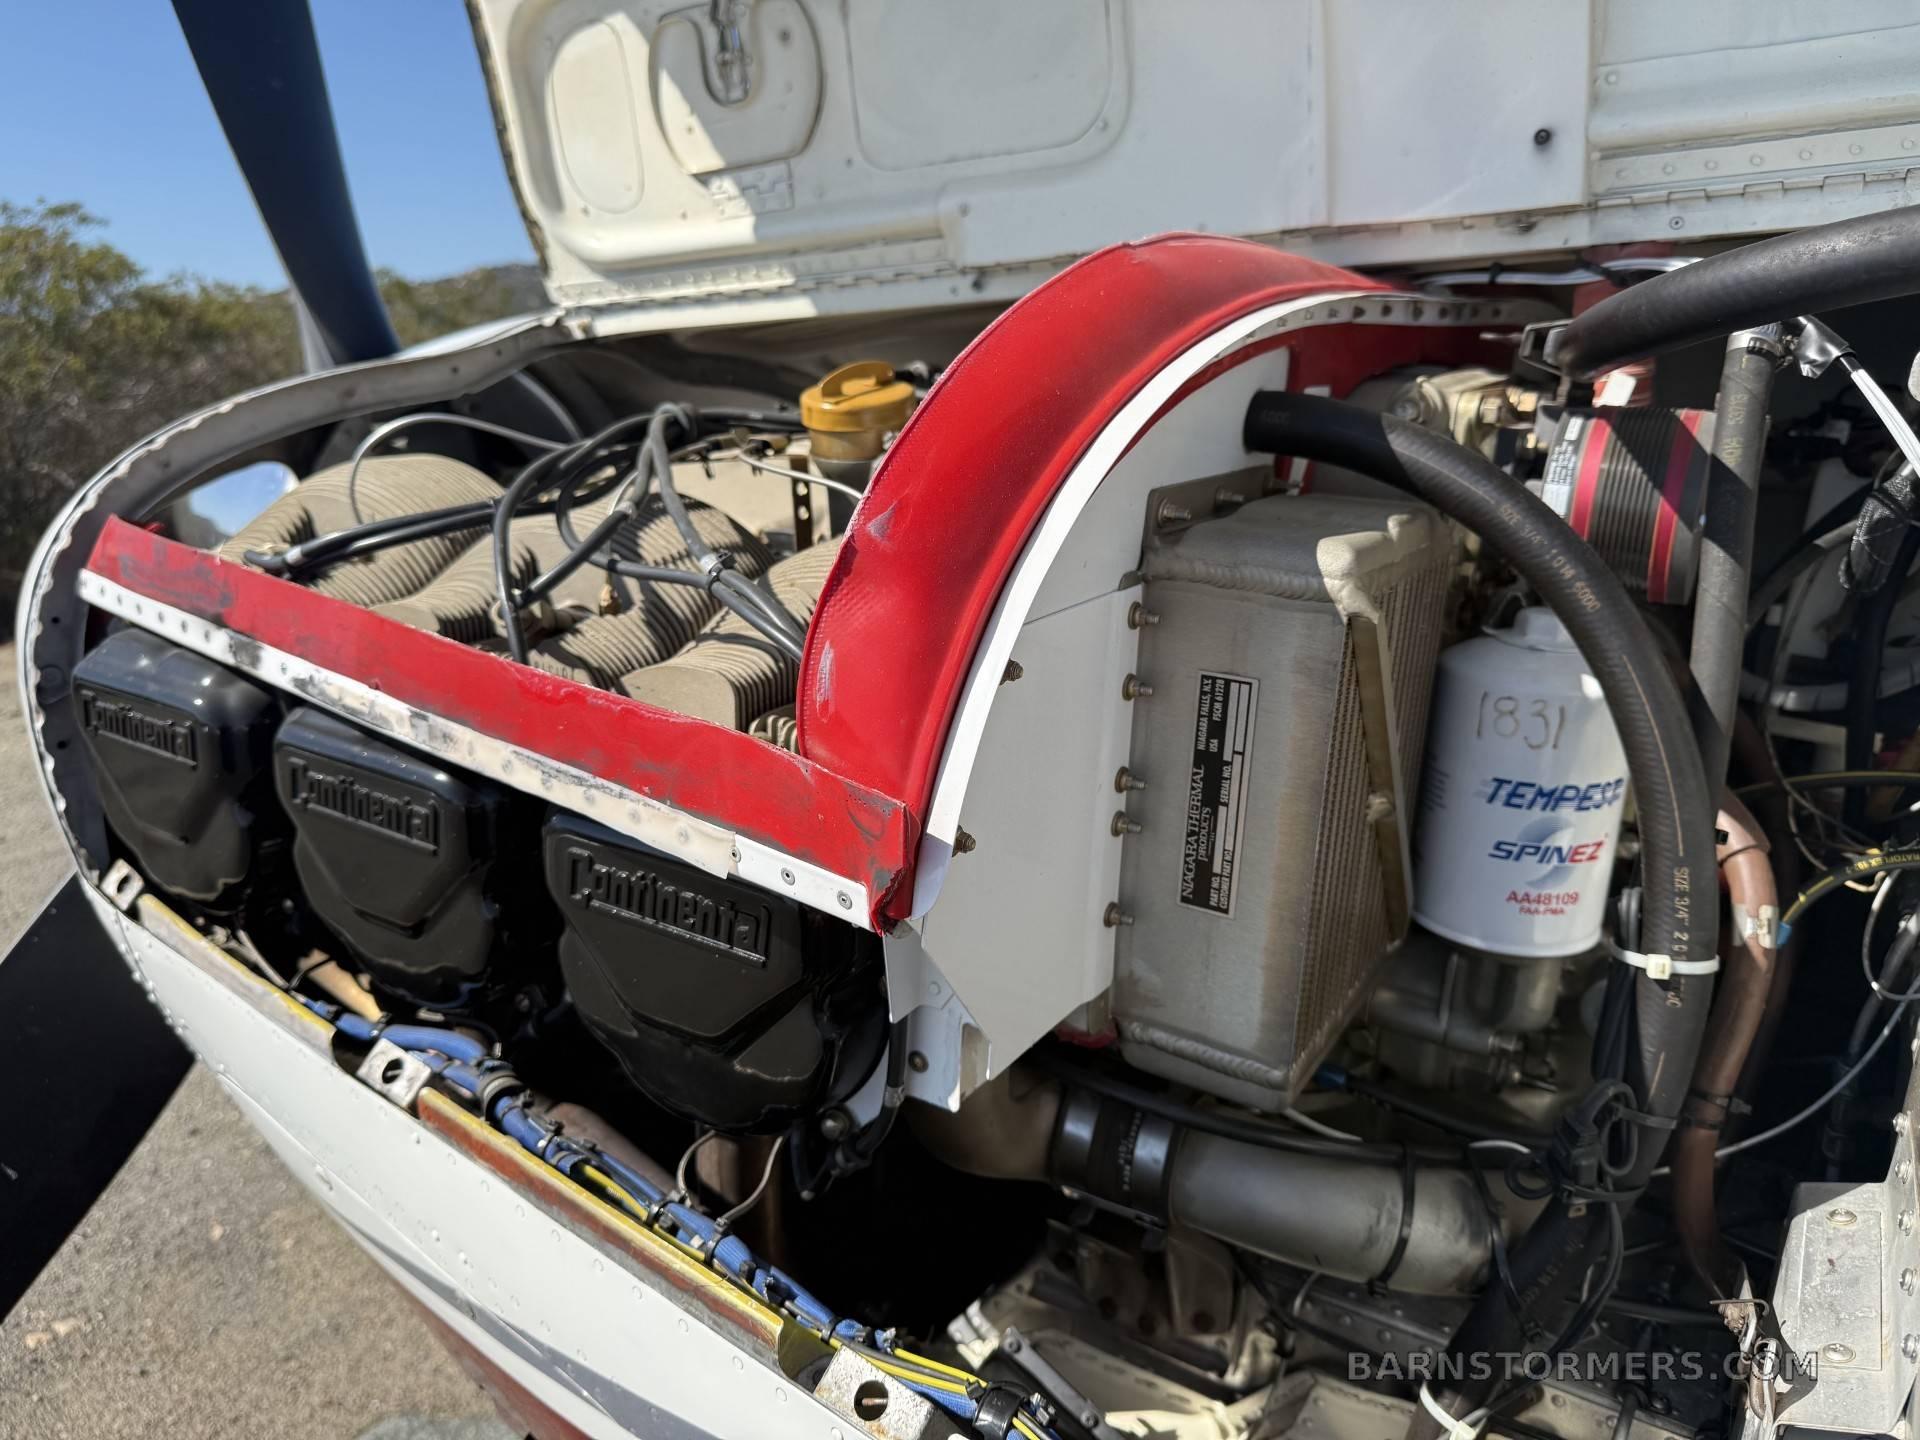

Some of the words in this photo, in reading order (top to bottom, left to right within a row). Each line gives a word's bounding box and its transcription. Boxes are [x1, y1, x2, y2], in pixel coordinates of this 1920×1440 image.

[1198, 718, 1208, 750] NIAGARA
[1476, 690, 1566, 751] 1831
[1209, 739, 1218, 752] USA
[290, 758, 438, 848] Continental
[1187, 764, 1205, 832] THERMAL
[1220, 779, 1230, 803] SERIAL
[1486, 777, 1624, 812] TEMPEST
[1182, 836, 1198, 898] NIAGARA
[1488, 839, 1604, 863] SPINEZ
[1672, 866, 1690, 893] SIZE
[568, 848, 770, 958] Continental
[1210, 890, 1219, 906] PART
